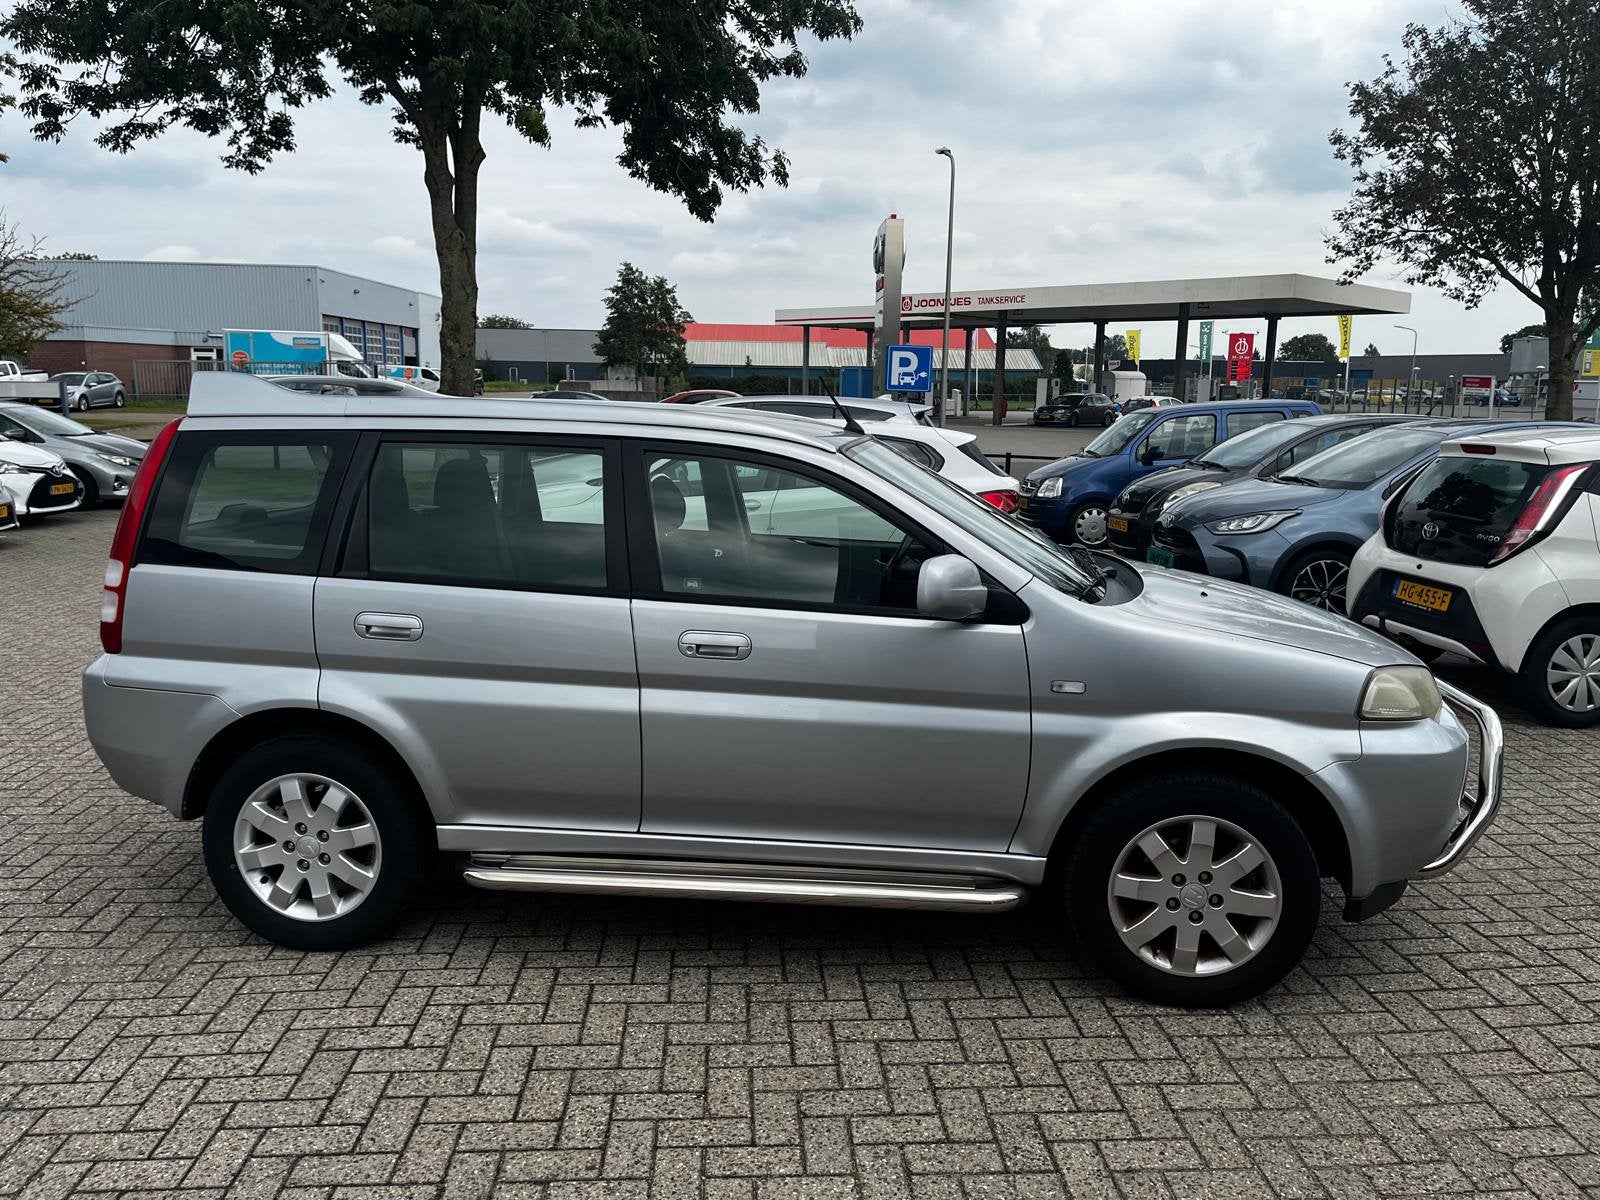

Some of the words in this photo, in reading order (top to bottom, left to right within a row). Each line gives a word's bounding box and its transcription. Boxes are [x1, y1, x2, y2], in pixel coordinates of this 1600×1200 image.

[914, 297, 971, 308] JOONJES
[977, 295, 1026, 305] TANKSERVICE
[891, 350, 919, 386] P
[1400, 583, 1449, 608] HG-455-F
